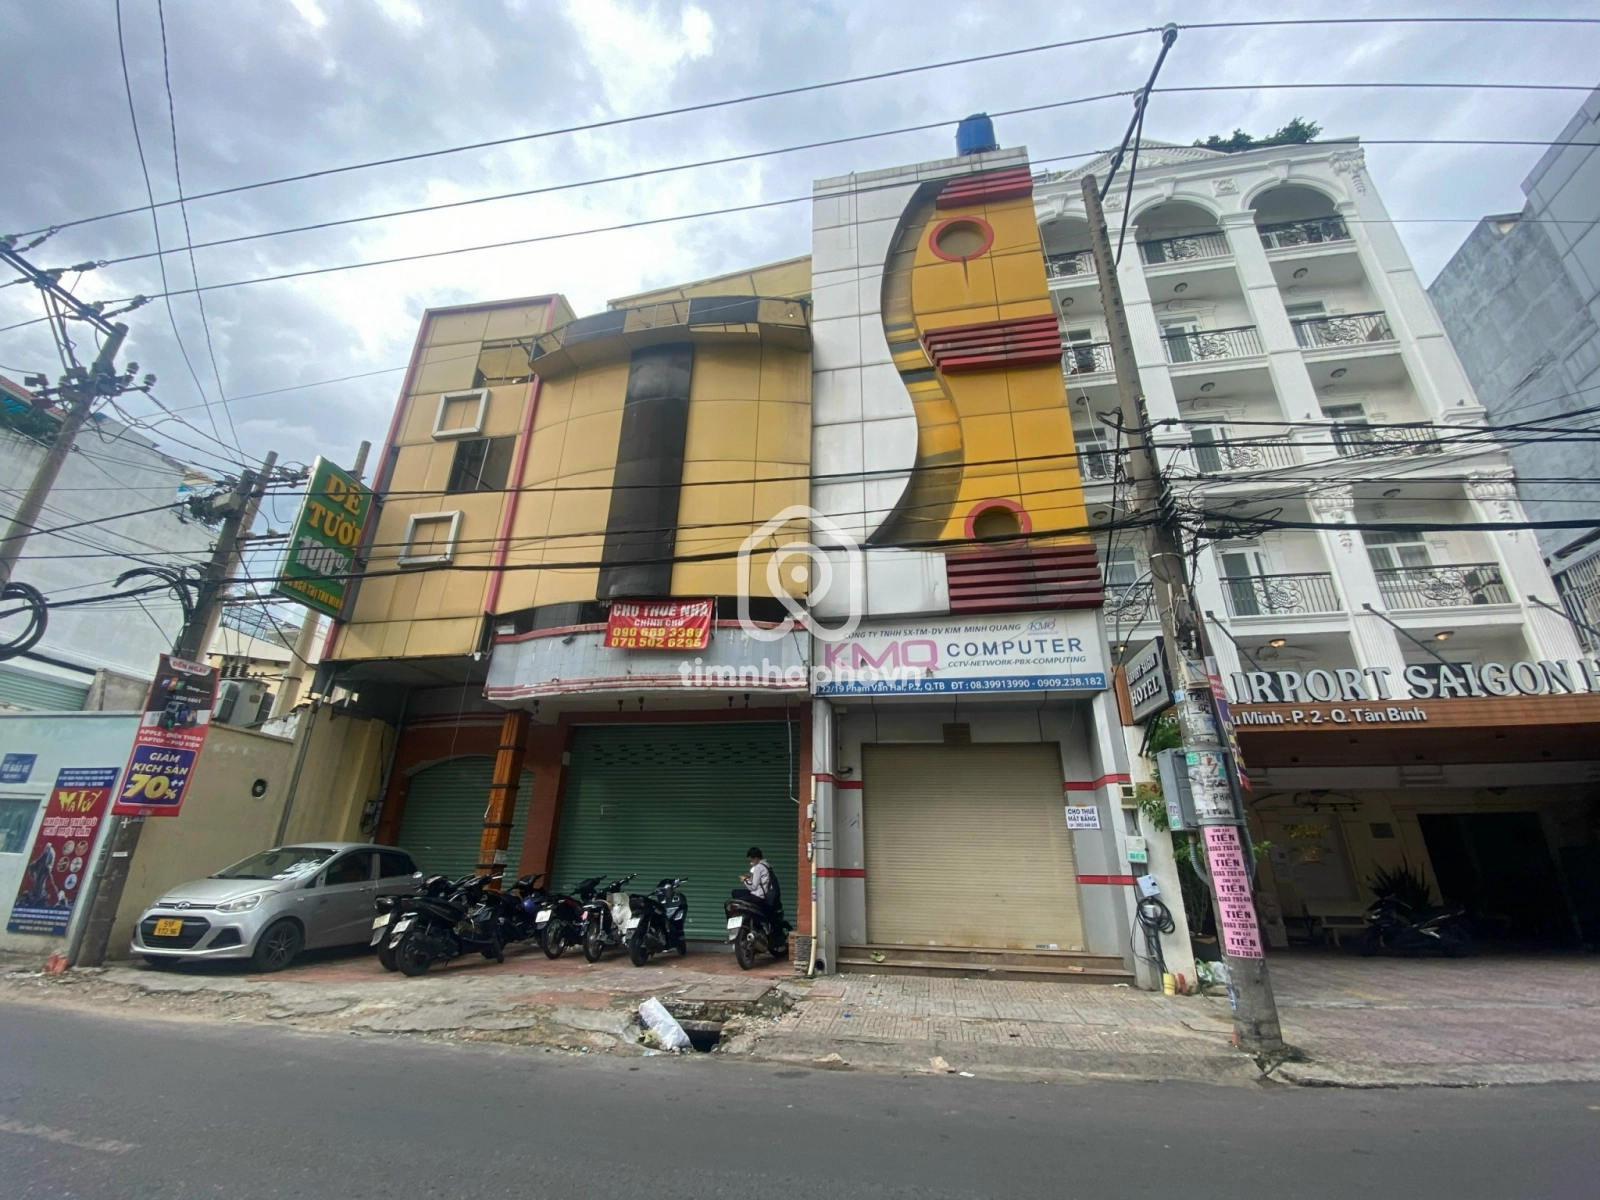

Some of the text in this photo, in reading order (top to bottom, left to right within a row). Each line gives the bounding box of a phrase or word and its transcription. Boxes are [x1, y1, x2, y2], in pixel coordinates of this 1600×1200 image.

[325, 473, 363, 515] DÊ
[295, 536, 351, 585] 100%
[643, 603, 676, 616] THUÊ
[868, 630, 878, 638] TY
[880, 629, 901, 638] TNHH
[945, 626, 961, 634] KIM
[964, 625, 987, 633] MINH
[989, 623, 1021, 632] QUANG
[611, 638, 636, 647] 070
[639, 638, 664, 648] 502
[824, 638, 1083, 670] KMQ COMPUTER
[188, 664, 208, 674] NGAY
[970, 679, 1030, 689] 08.39913990
[1037, 676, 1102, 687] 0909.238.182
[1230, 666, 1391, 703] IRPORT
[1404, 659, 1576, 699] SAIGON
[1131, 676, 1160, 706] HOTEL
[1242, 707, 1283, 726] Minh
[1351, 707, 1386, 723] Tân
[1387, 706, 1427, 722] Bình
[140, 729, 162, 737] APPLE
[1081, 807, 1095, 815] THUÊ
